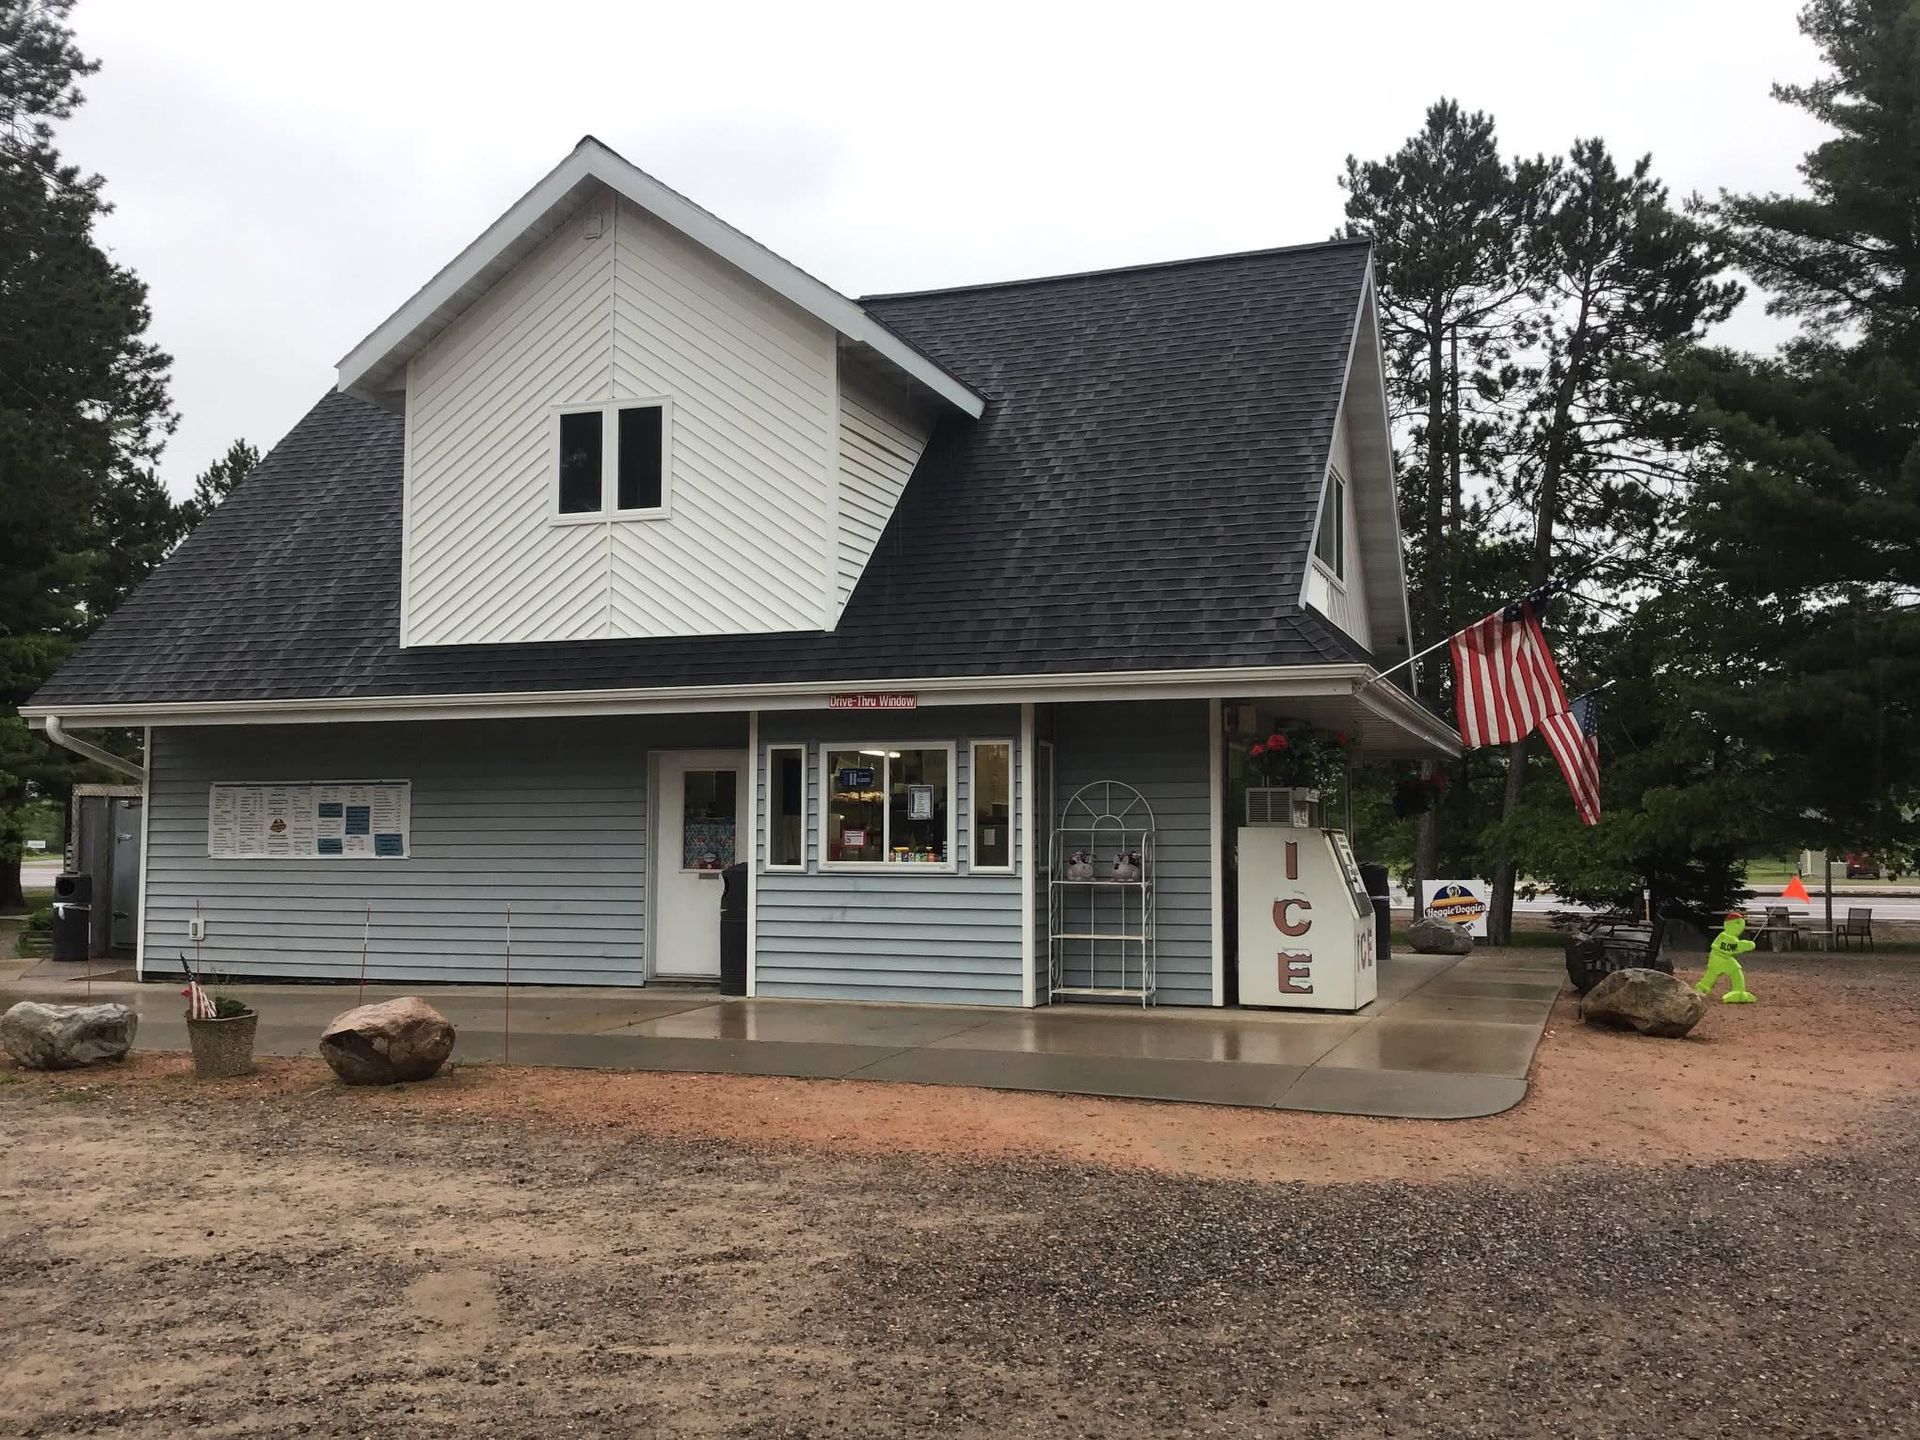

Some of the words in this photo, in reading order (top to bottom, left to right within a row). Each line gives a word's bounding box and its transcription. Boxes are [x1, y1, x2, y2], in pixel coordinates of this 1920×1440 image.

[830, 695, 877, 707] Drive-Thru
[879, 694, 914, 707] Window
[1272, 839, 1314, 995] ICE
[1356, 926, 1373, 973] ICE
